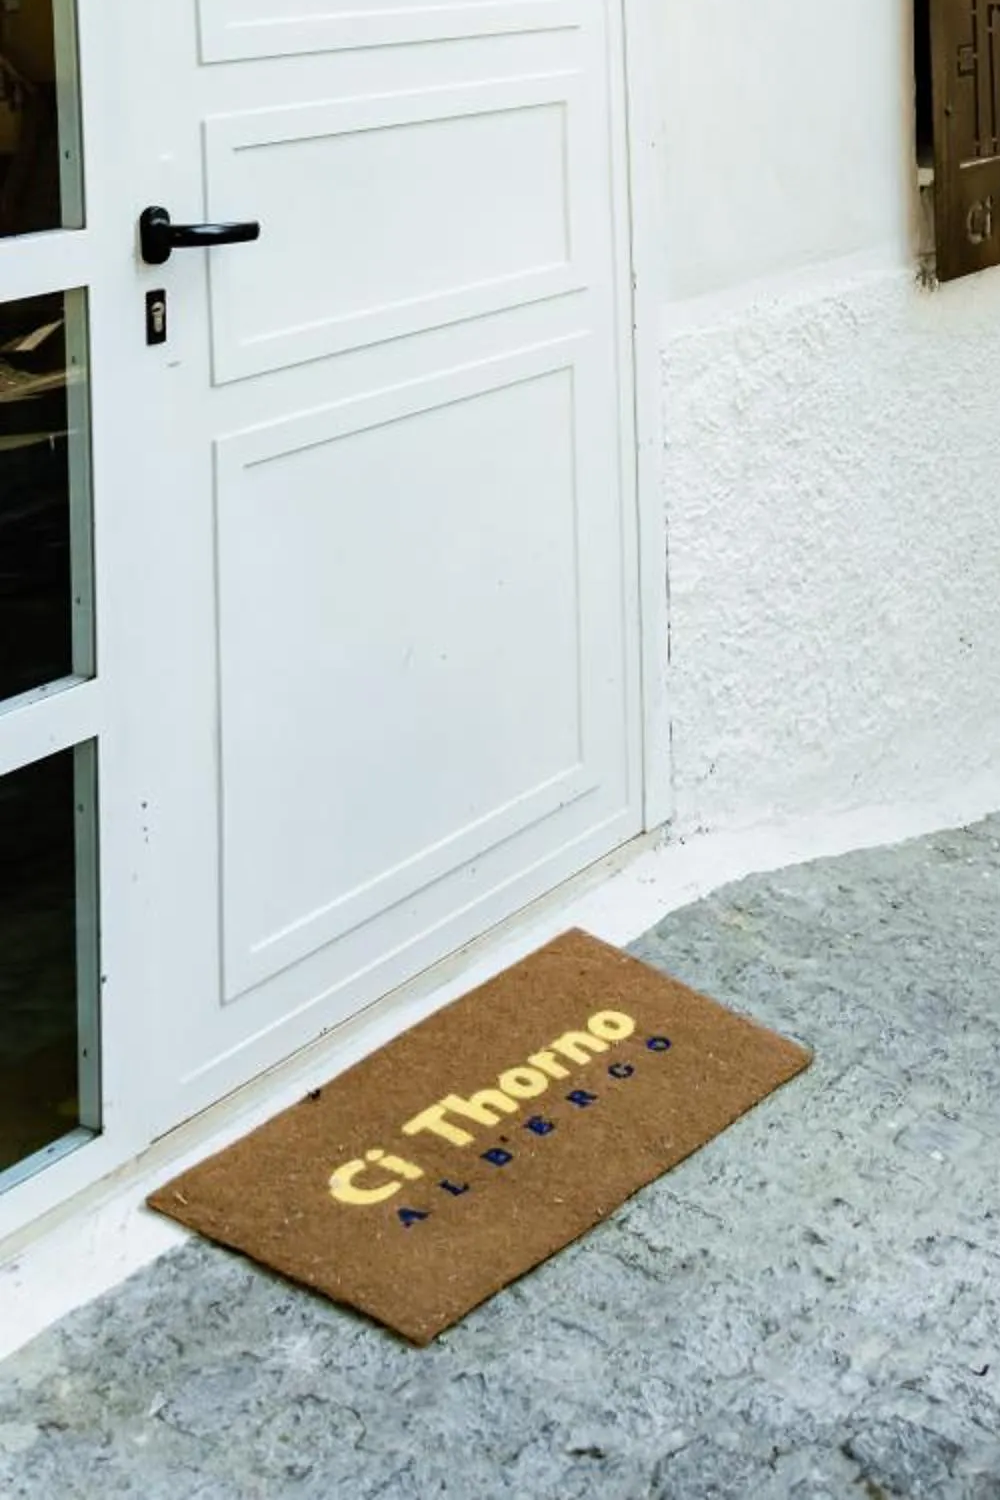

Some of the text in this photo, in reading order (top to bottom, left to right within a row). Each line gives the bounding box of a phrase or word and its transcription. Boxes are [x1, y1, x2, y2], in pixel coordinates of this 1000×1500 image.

[966, 195, 993, 244] Ci
[329, 1009, 636, 1205] Ci Thorno
[397, 1036, 671, 1227] ALBERGO
